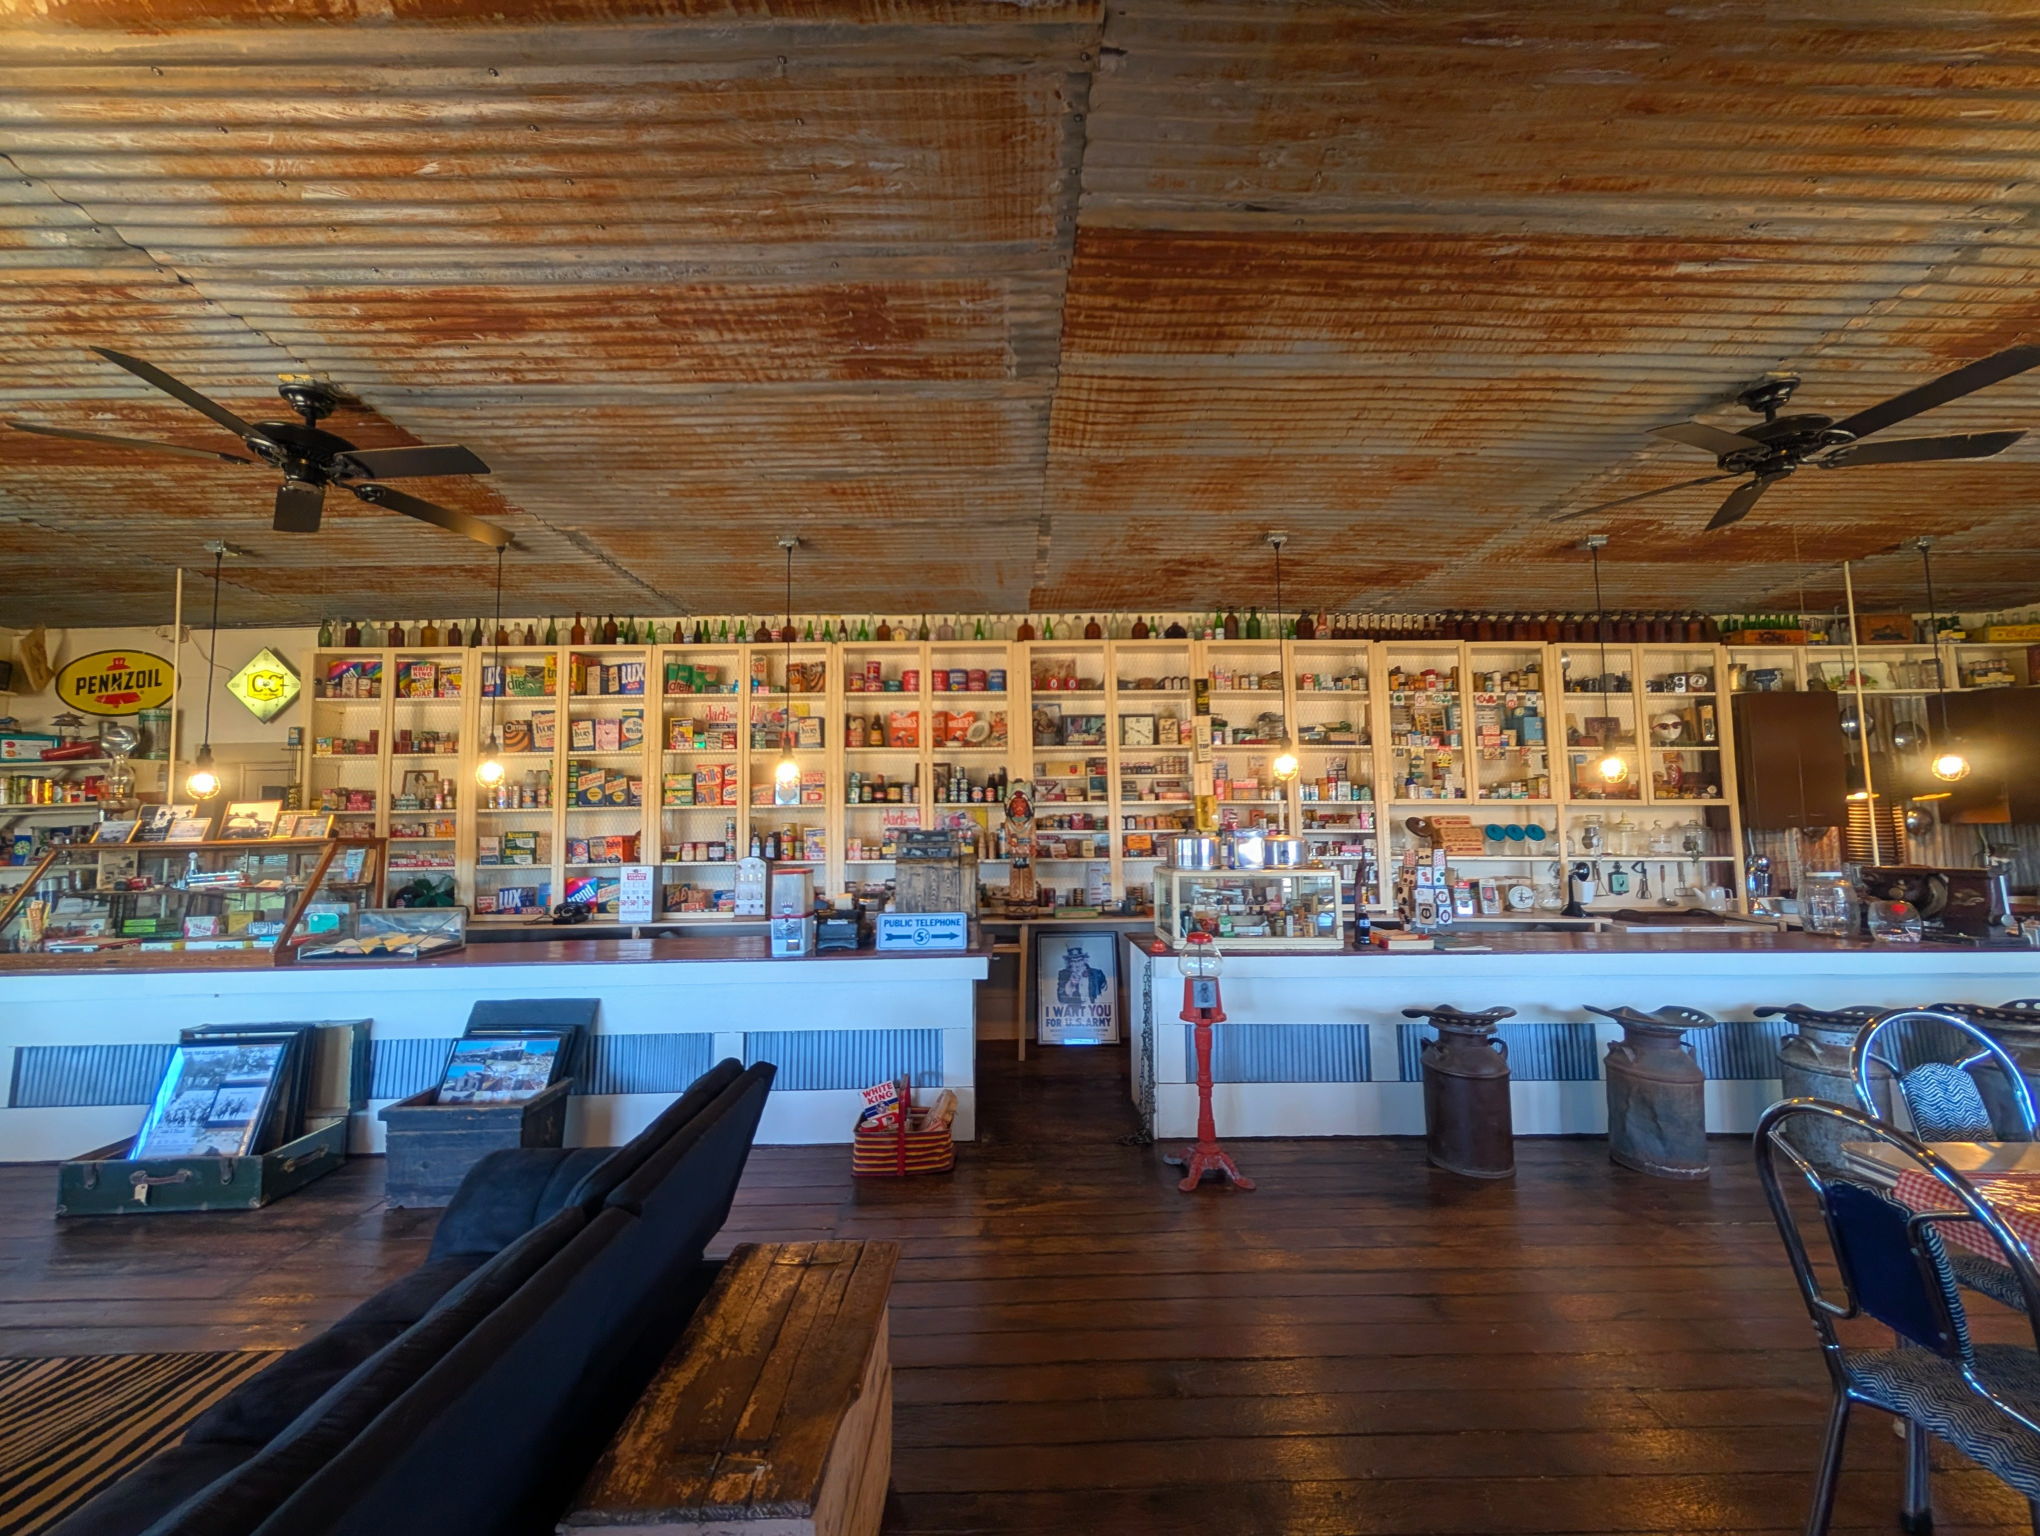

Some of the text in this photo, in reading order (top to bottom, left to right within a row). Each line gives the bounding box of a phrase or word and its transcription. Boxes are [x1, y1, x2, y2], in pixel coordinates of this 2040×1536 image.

[621, 663, 645, 684] LUX
[75, 669, 162, 696] PENNZOIL
[696, 768, 721, 783] Brillo
[498, 888, 522, 910] LUX
[567, 884, 596, 903] trend
[884, 918, 961, 928] PUBLIC TELEPHONE
[1045, 1004, 1112, 1018] I WANT YOU
[1045, 1018, 1062, 1027] FOR
[1086, 1017, 1112, 1027] ARMY
[862, 1082, 893, 1098] WHITE
[867, 1090, 893, 1105] KING
